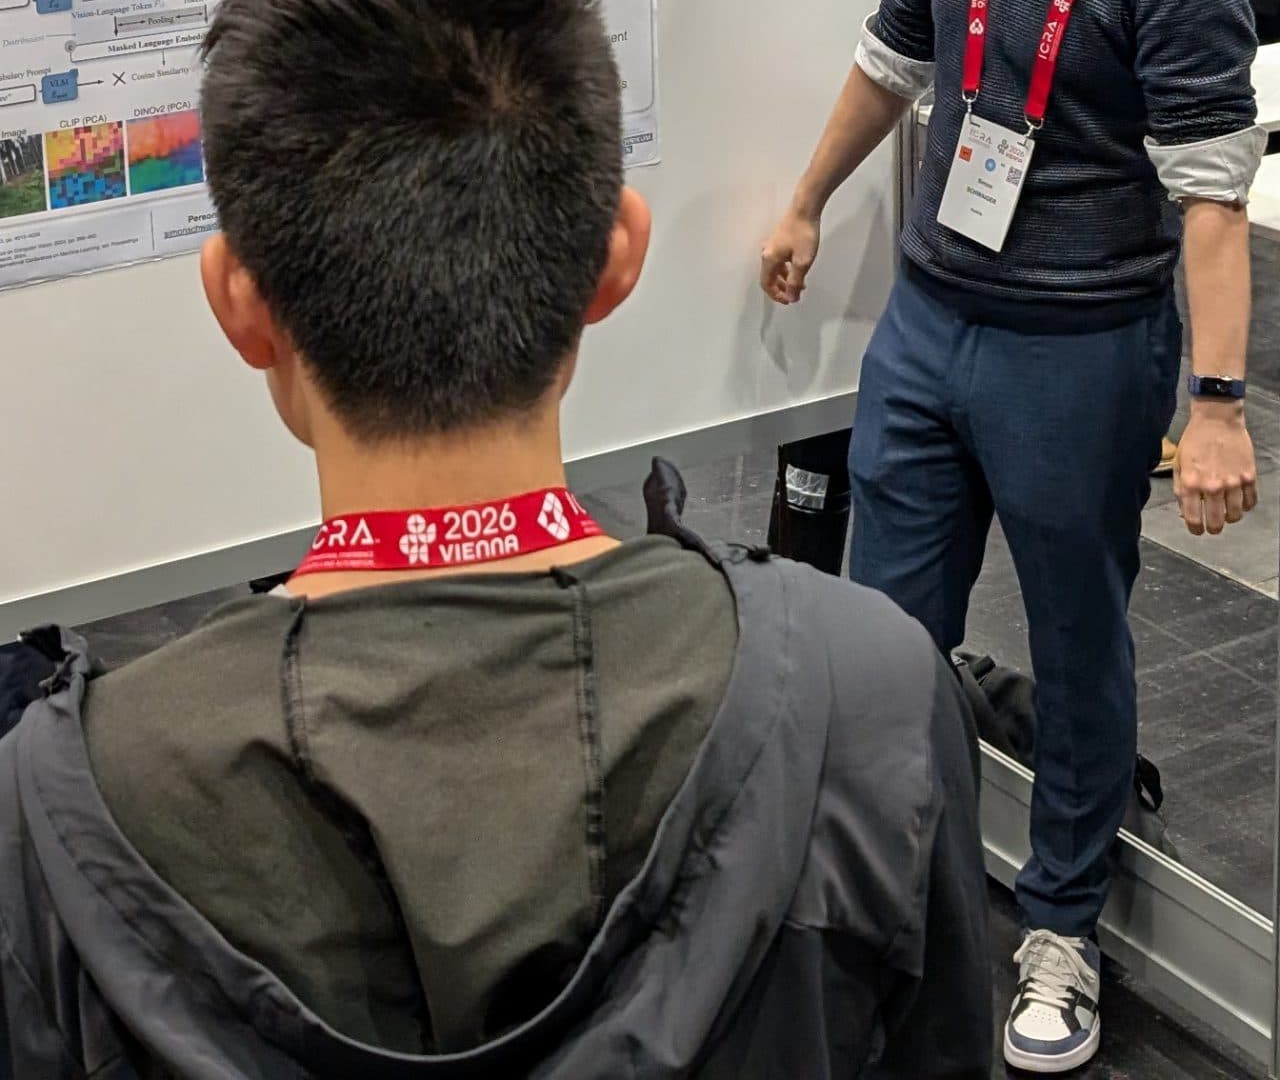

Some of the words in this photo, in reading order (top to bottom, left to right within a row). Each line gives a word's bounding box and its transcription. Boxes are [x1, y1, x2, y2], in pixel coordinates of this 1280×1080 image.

[1038, 20, 1057, 60] ICRA
[60, 118, 80, 128] CLIP
[83, 114, 107, 124] (PCA)
[134, 105, 165, 116] DINOv2
[168, 101, 190, 111] (PCA)
[1, 128, 27, 140] Image
[312, 517, 375, 550] CRA
[443, 503, 516, 540] 2026
[439, 537, 519, 563] VIENNA
